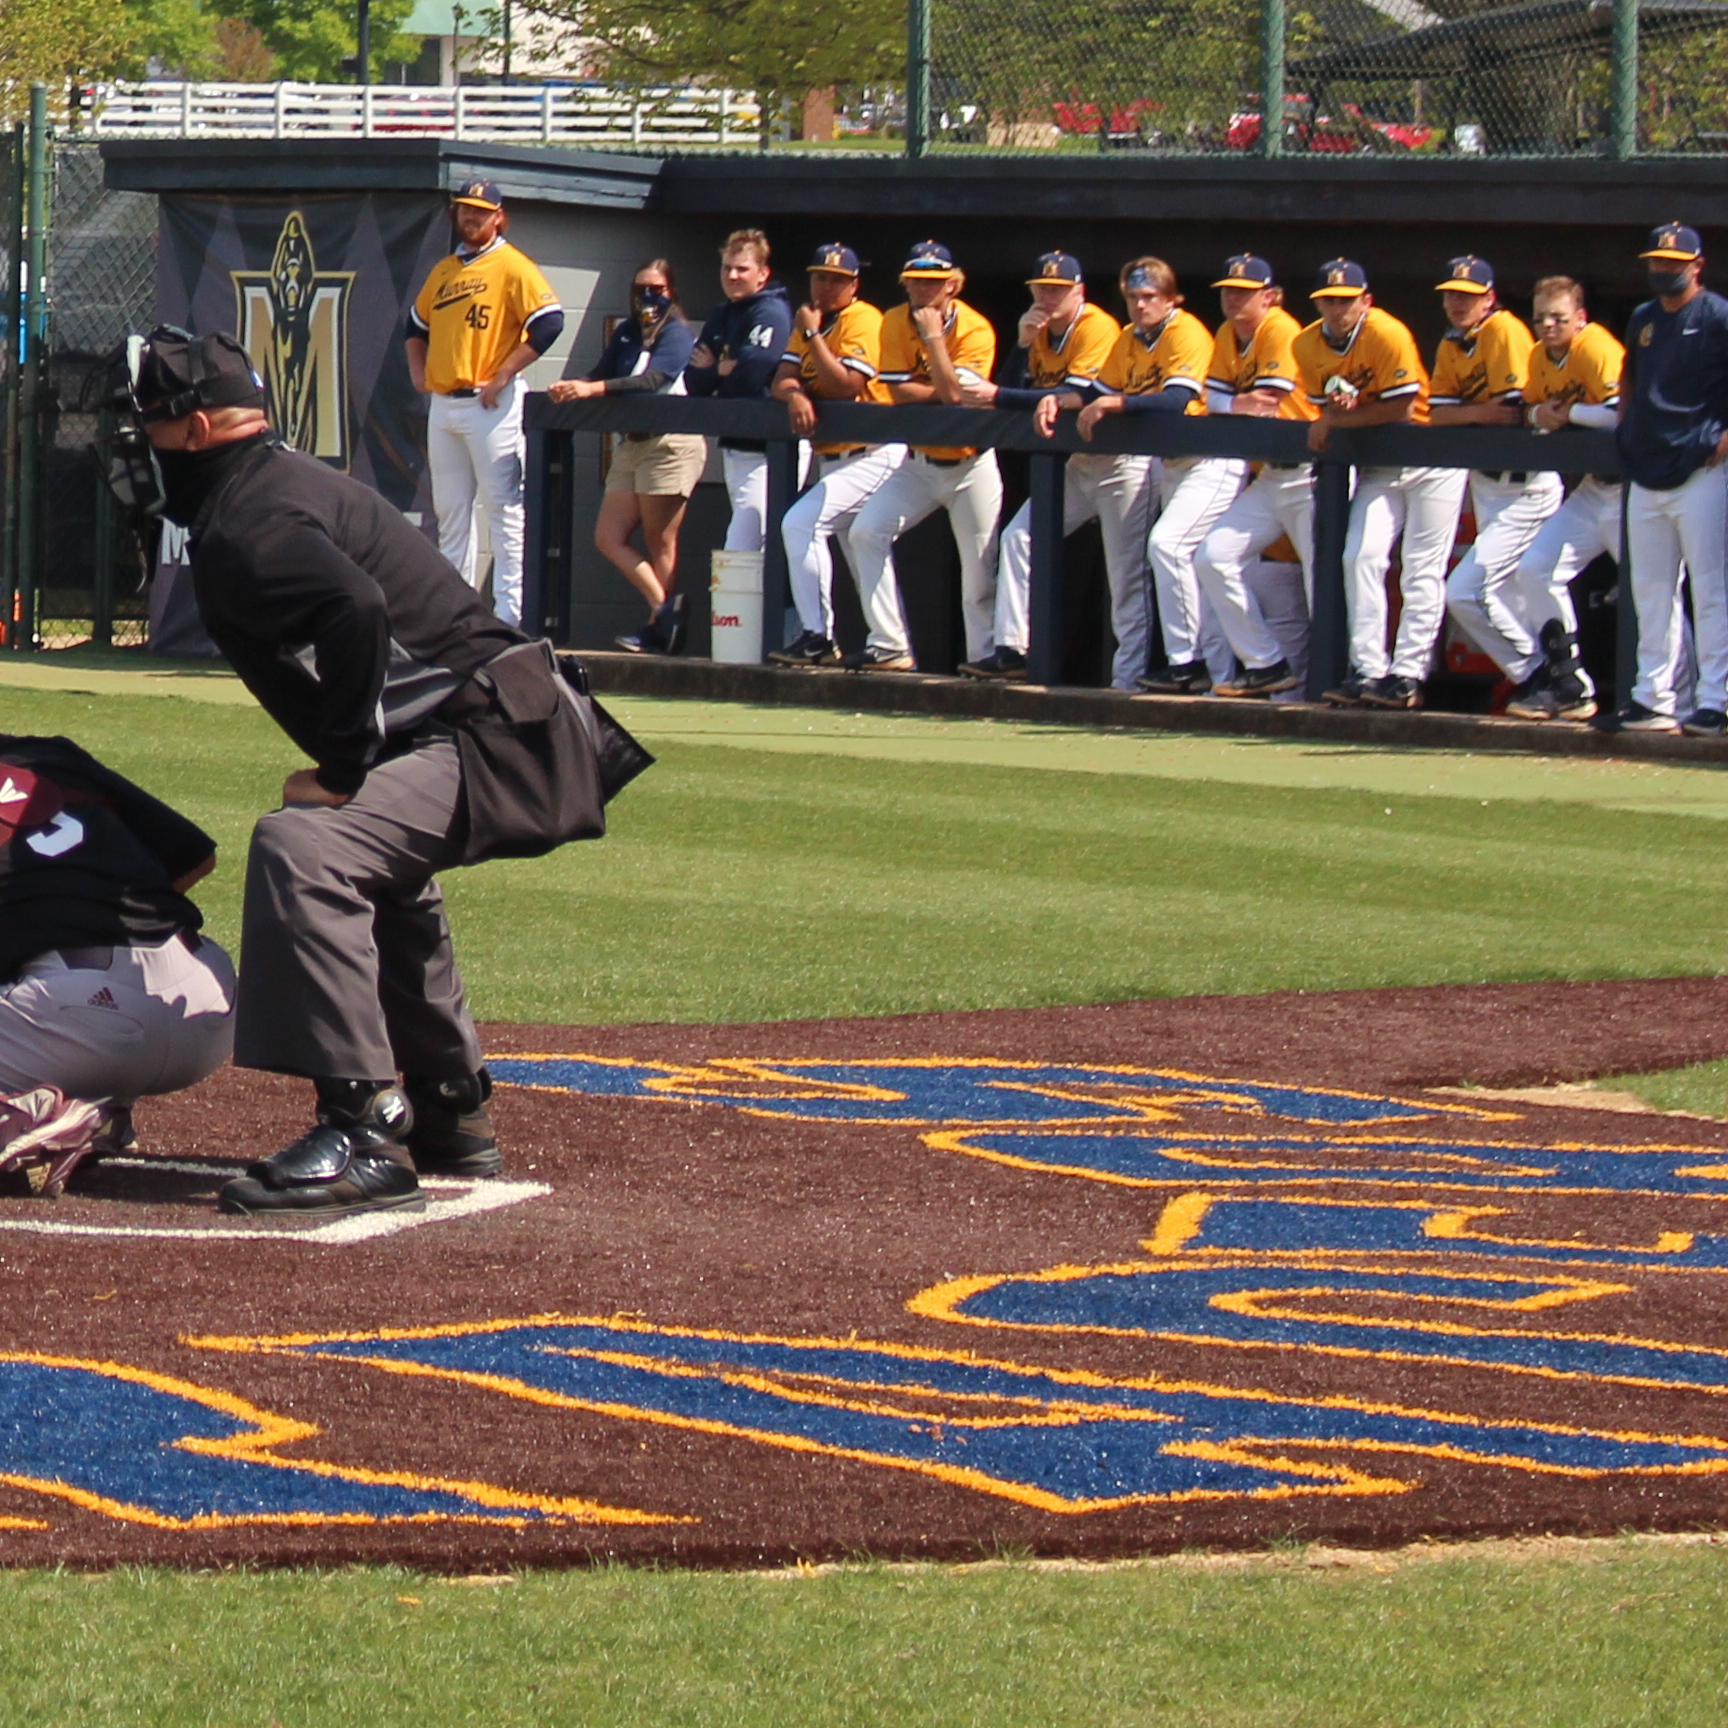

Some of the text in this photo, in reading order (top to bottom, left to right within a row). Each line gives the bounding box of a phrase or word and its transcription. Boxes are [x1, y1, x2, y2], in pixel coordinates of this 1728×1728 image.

[432, 277, 487, 306] Murray
[465, 303, 491, 330] 45
[748, 324, 774, 349] 44
